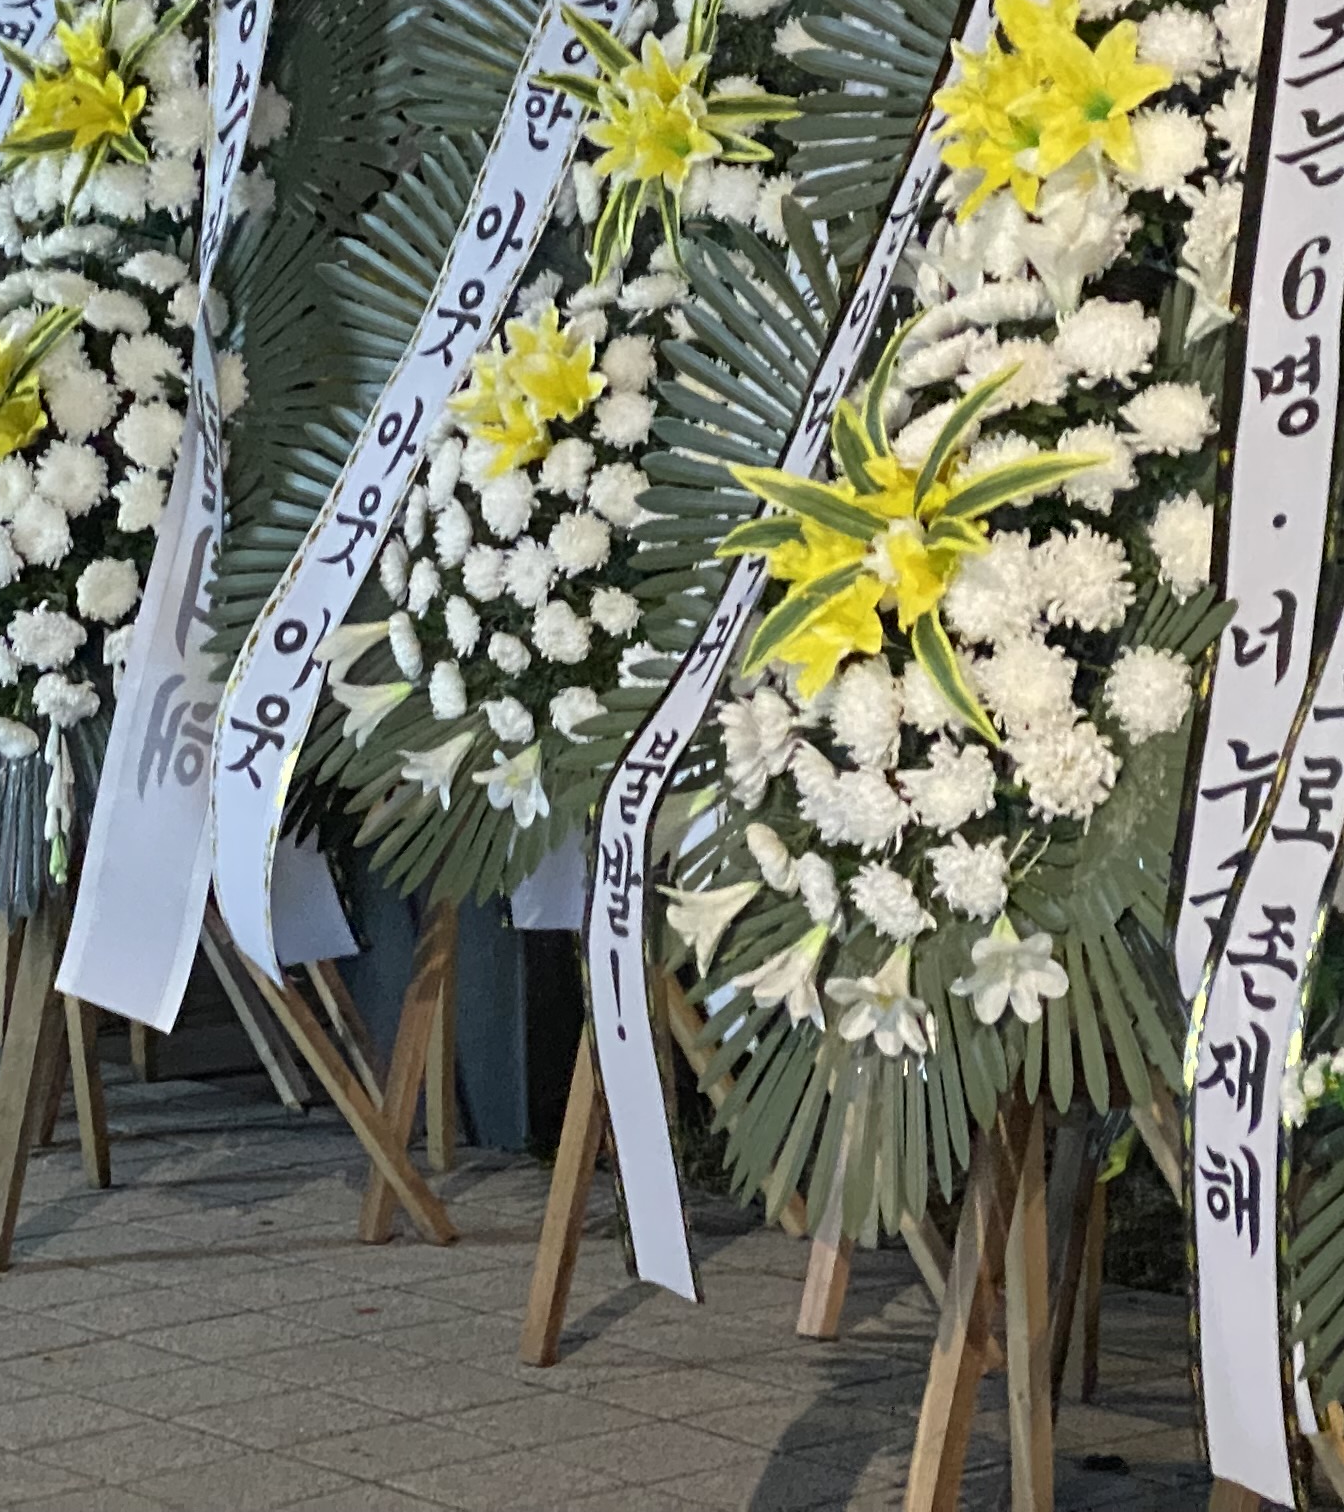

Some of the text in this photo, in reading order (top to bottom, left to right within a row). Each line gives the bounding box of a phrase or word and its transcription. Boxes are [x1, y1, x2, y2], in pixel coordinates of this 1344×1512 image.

[419, 188, 525, 368] 아웃
[317, 395, 425, 578] 아웃
[227, 607, 332, 789] 아웃
[1230, 588, 1298, 686] 너
[1197, 904, 1299, 1261] 존재해
